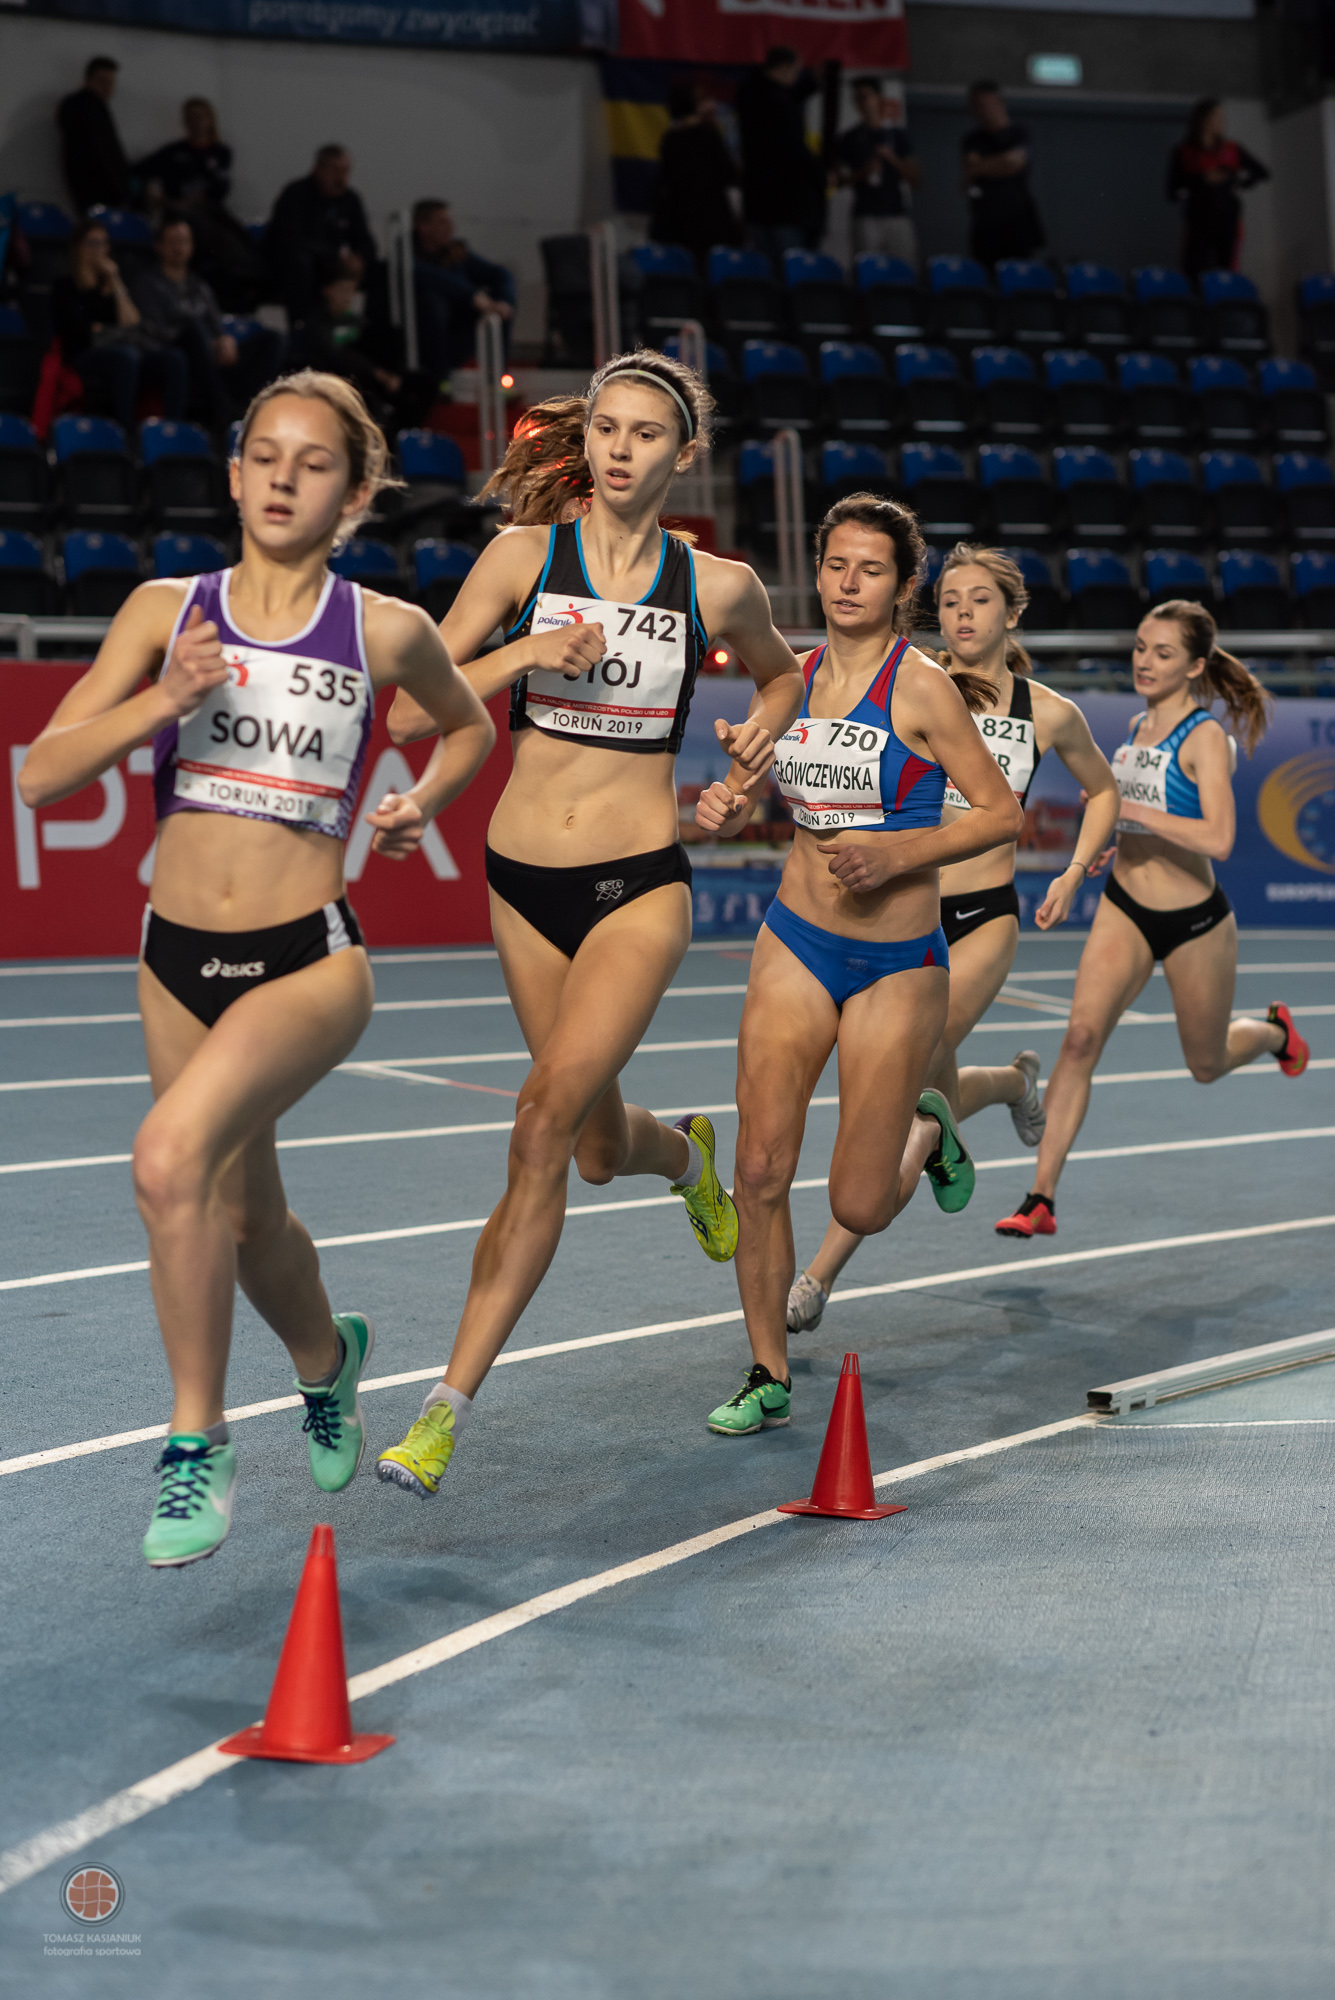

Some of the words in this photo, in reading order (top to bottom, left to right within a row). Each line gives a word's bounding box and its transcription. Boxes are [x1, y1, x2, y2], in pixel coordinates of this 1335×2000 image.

[617, 608, 677, 643] 742
[288, 664, 358, 706] 535
[210, 711, 323, 761] SOWA
[552, 712, 602, 731] TORUŃ
[607, 719, 643, 734] 2019
[780, 733, 801, 742] olanik
[827, 722, 878, 752] 750
[982, 718, 1027, 744] 821
[773, 756, 874, 791] GŁÓWCZEWSKA
[209, 782, 269, 808] TORUŃ
[273, 795, 315, 815] 2019
[824, 812, 855, 826] 2019
